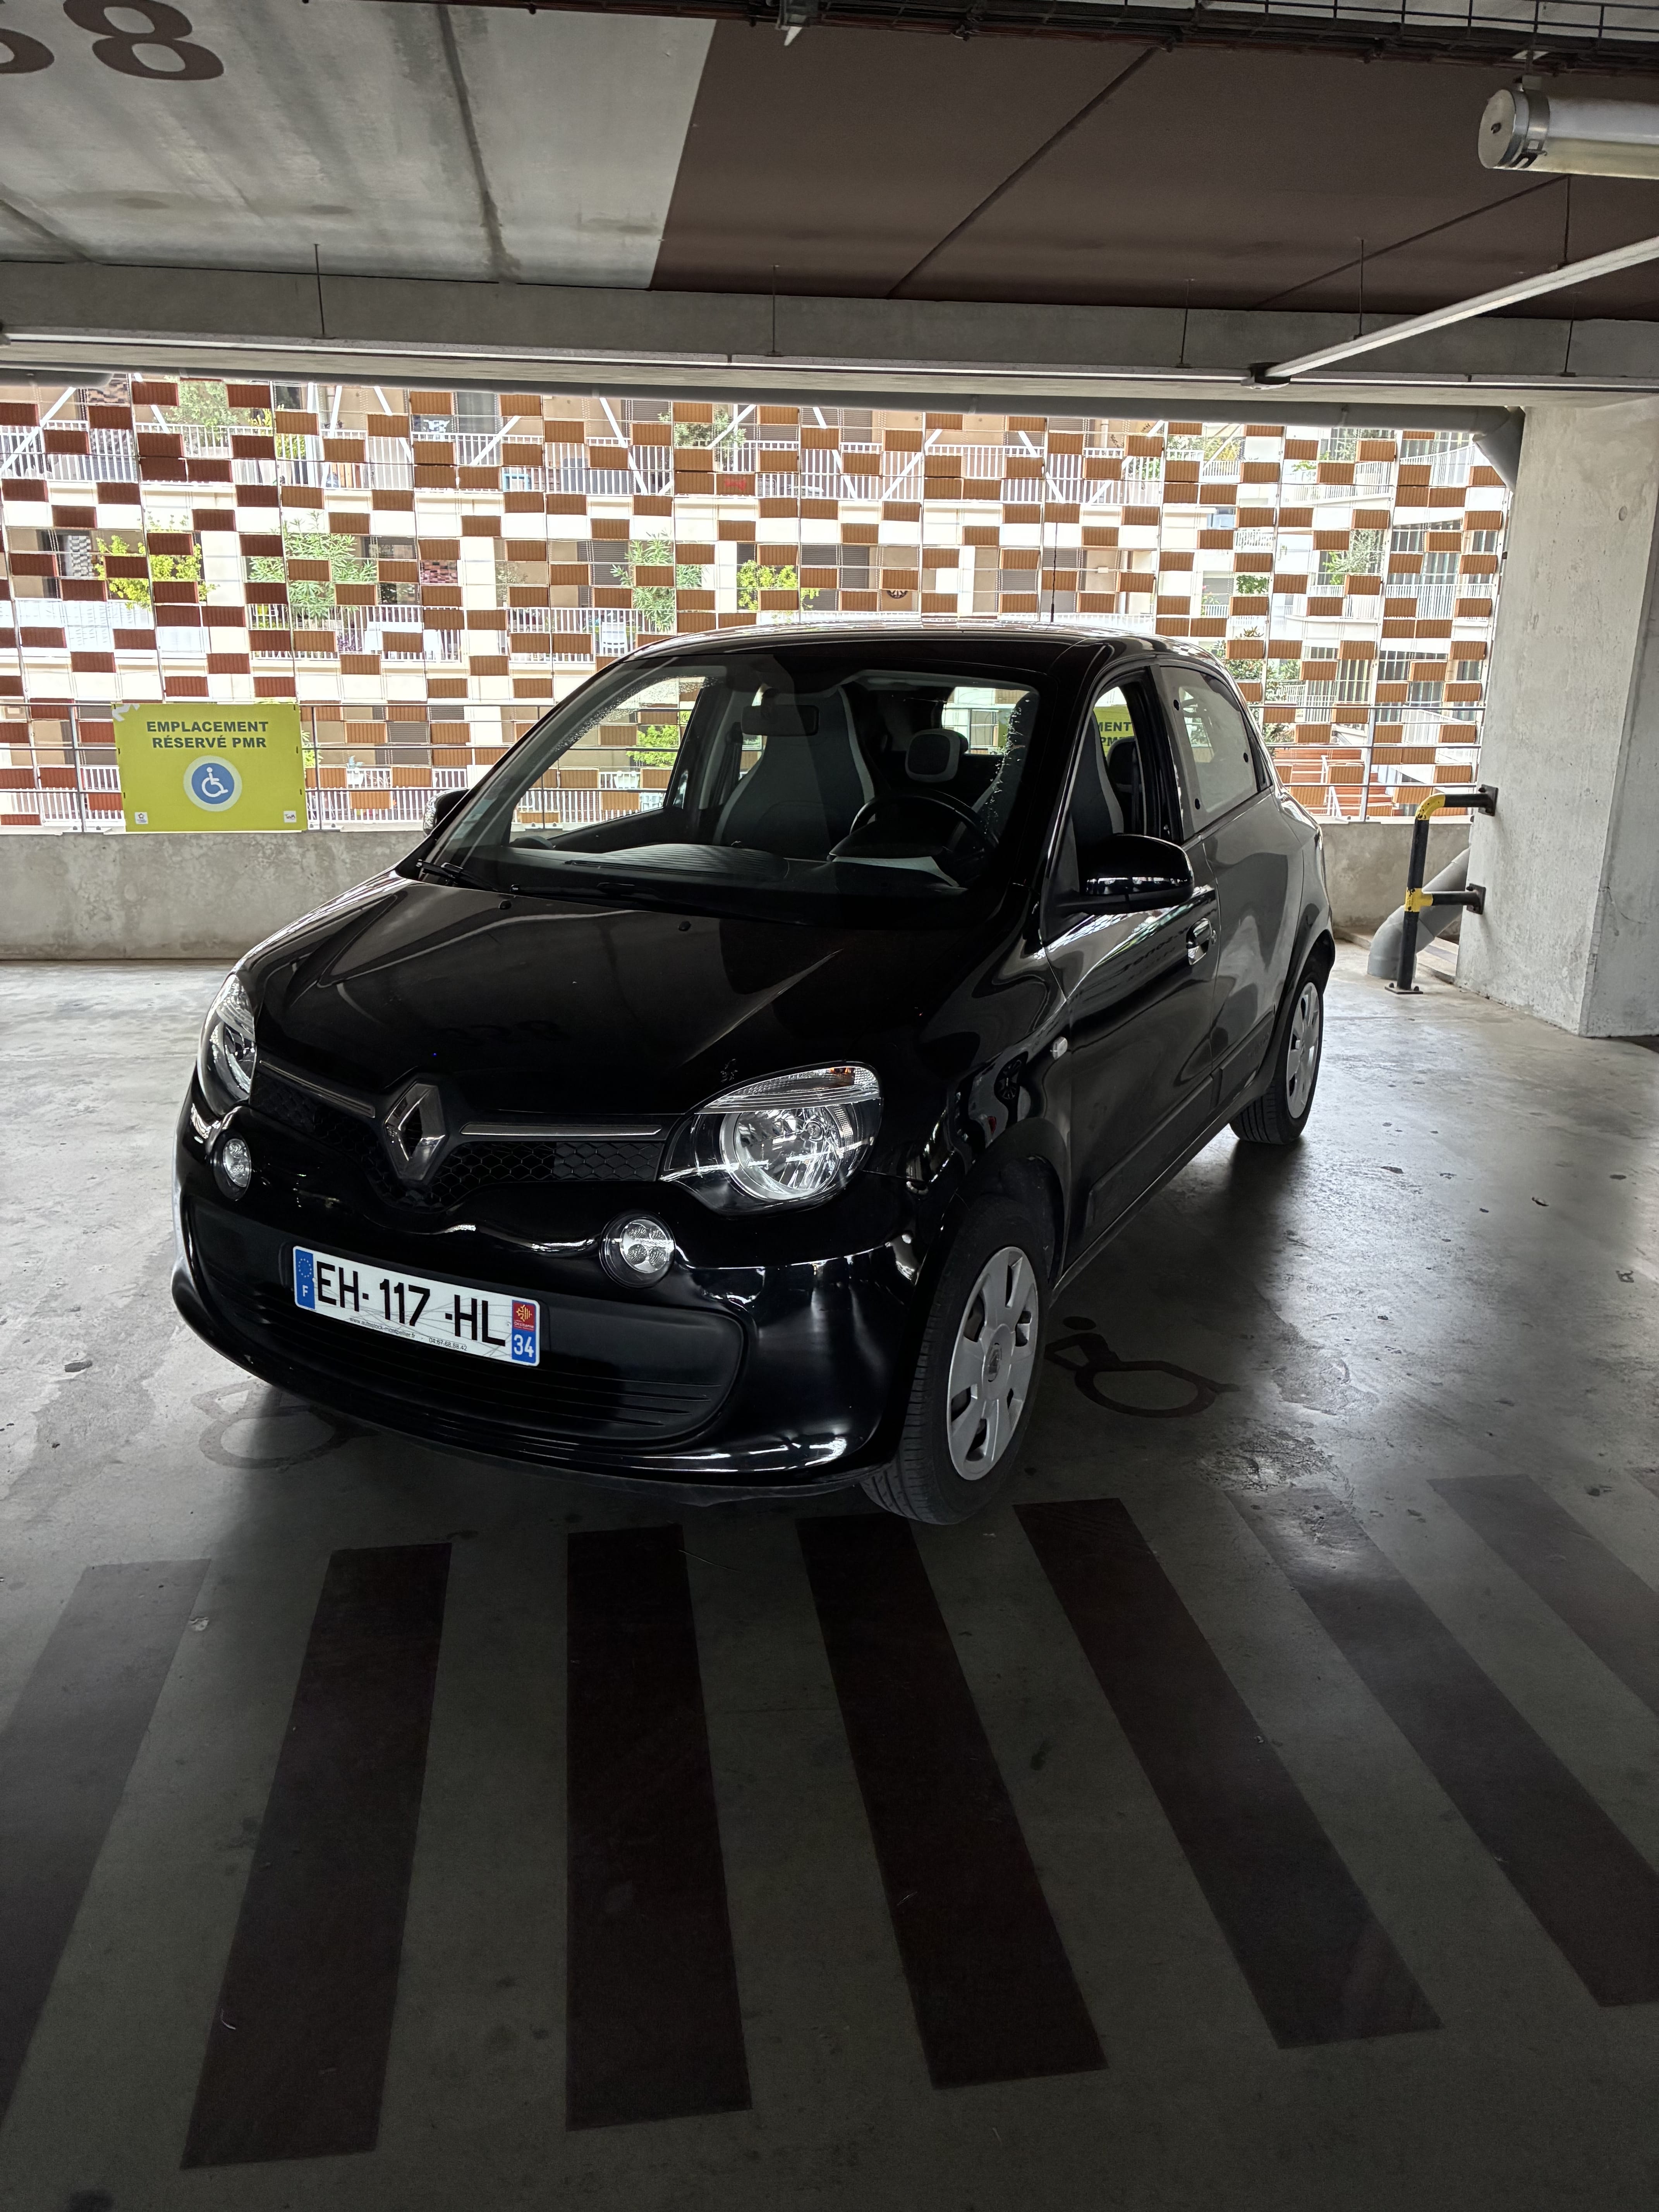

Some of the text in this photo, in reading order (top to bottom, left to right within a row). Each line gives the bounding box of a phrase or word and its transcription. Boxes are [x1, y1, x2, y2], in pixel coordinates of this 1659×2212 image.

[147, 721, 268, 732] EMPLACEMENT
[153, 735, 267, 748] RÉSERVÉ PMR
[302, 1285, 309, 1297] F
[514, 1334, 534, 1357] 34
